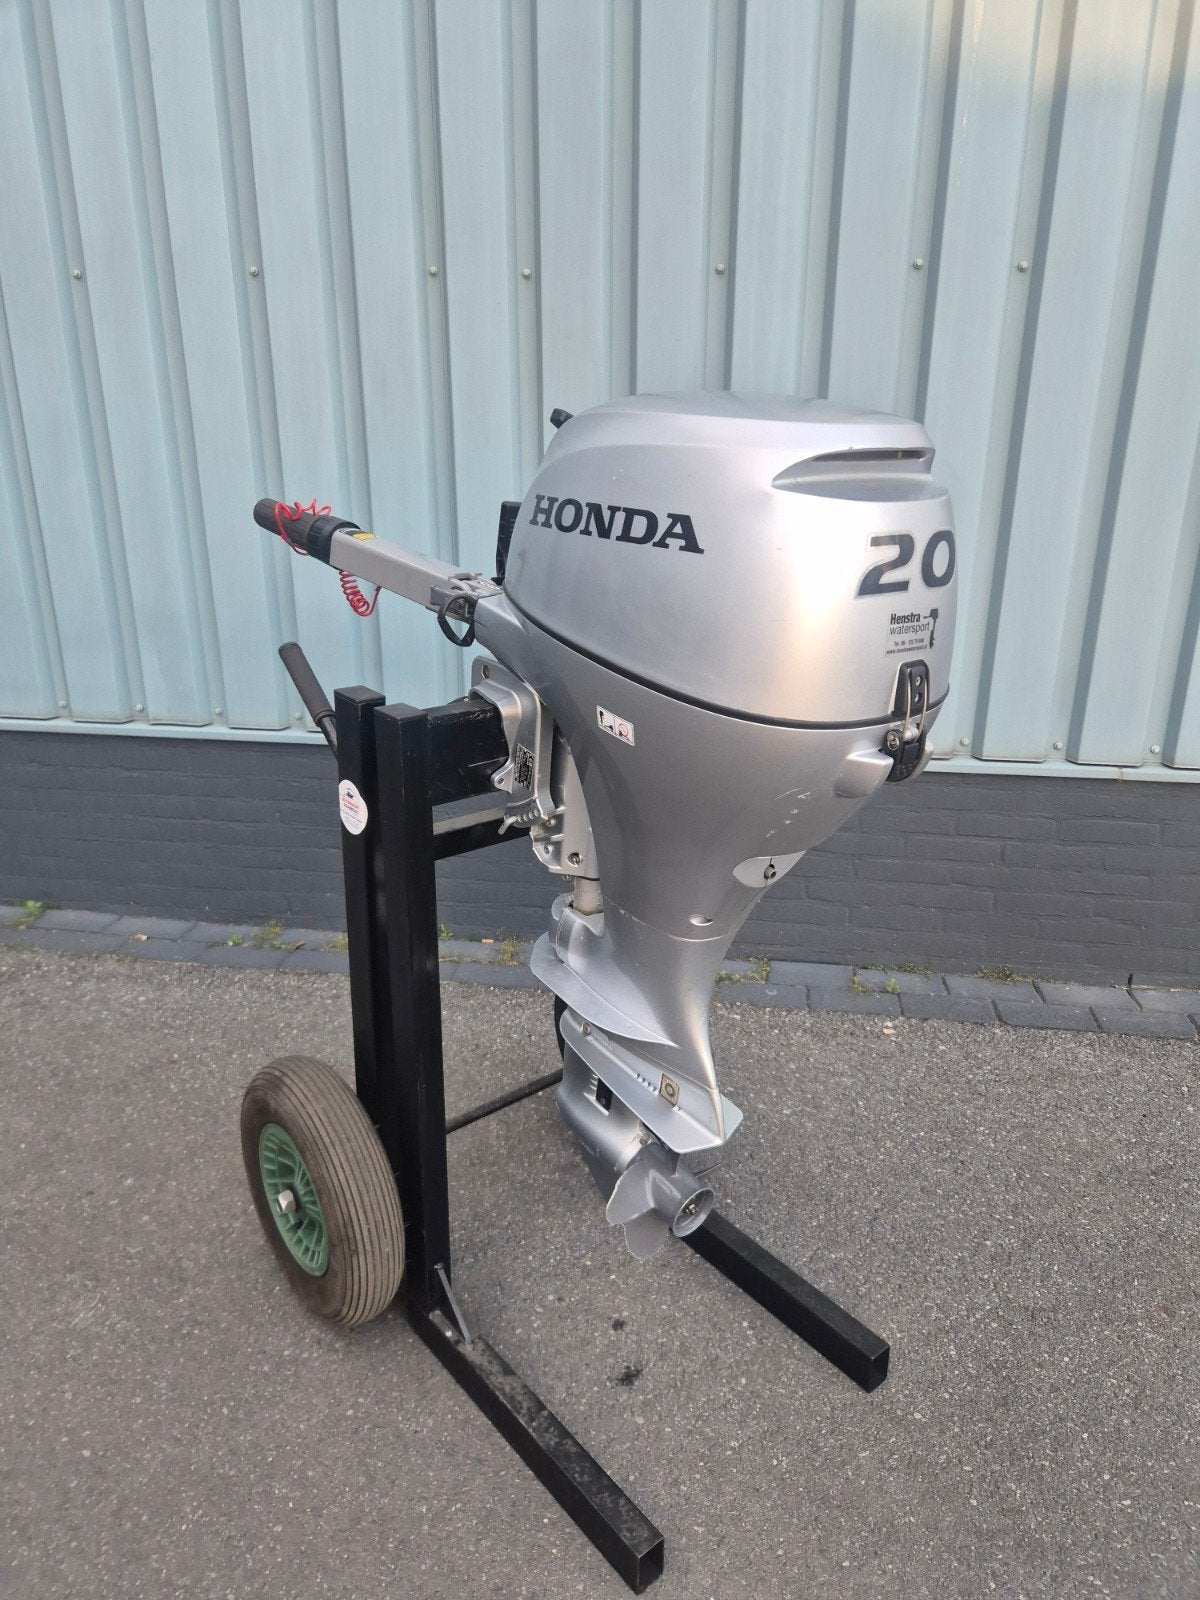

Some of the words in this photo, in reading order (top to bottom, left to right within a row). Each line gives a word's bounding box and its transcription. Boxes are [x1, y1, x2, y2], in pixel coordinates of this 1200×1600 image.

[529, 494, 705, 554] HONDA
[858, 529, 956, 596] 20
[890, 612, 921, 625] Henstra
[890, 621, 930, 635] watersport
